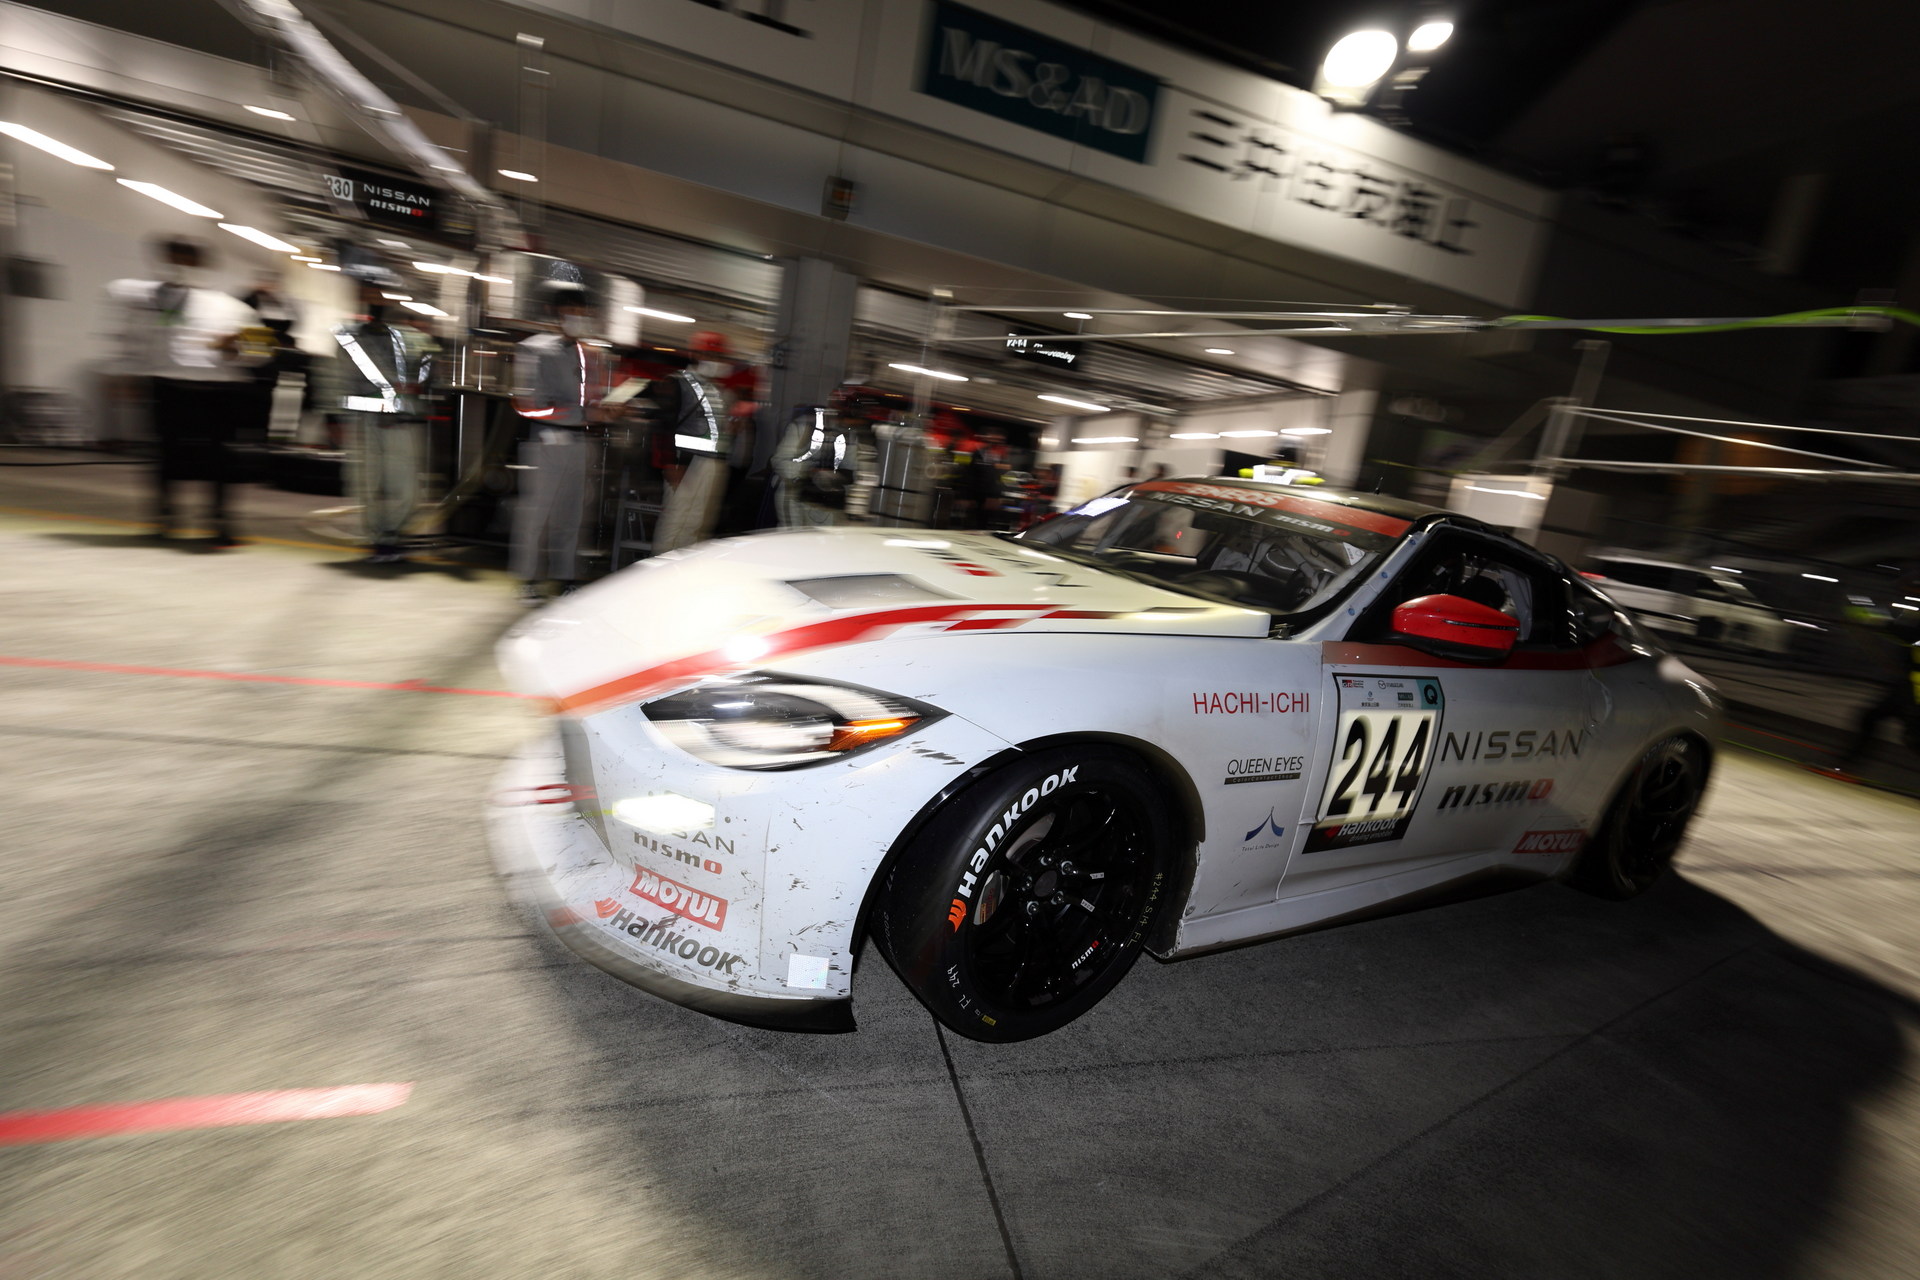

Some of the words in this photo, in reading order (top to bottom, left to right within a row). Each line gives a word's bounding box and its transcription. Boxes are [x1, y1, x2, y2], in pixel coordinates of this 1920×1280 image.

[940, 26, 1150, 135] MS&AD
[363, 183, 430, 207] NISSAN
[370, 199, 423, 217] nismo
[1151, 491, 1265, 517] NISSAN
[1191, 485, 1285, 506] ENEOS
[1193, 692, 1309, 714] HACHI-ICHI
[1423, 684, 1438, 705] Q
[1440, 729, 1584, 762] NISSAN
[1227, 758, 1272, 775] QUEEN
[1274, 756, 1304, 771] EYES
[1326, 715, 1431, 817] 244
[1437, 778, 1555, 809] nismo
[957, 765, 1079, 898] Hankook
[1518, 832, 1584, 851] MOTUL
[633, 831, 723, 875] nismo
[635, 870, 721, 925] MOTUL
[610, 907, 741, 975] Hankook
[1071, 940, 1100, 969] nismo
